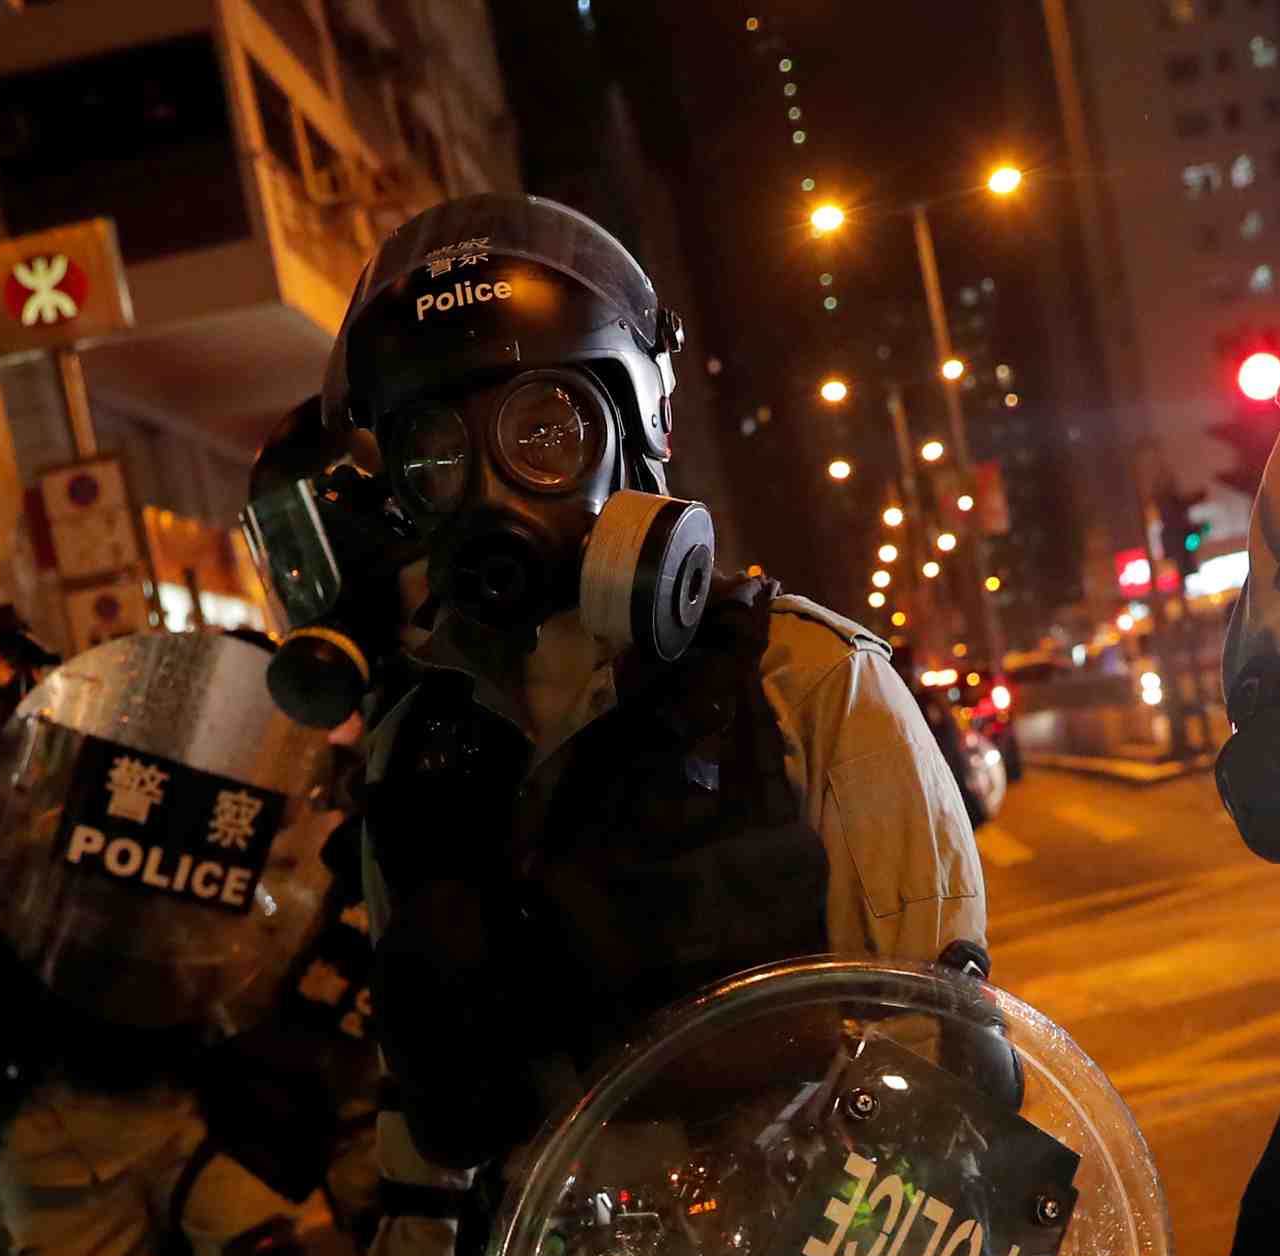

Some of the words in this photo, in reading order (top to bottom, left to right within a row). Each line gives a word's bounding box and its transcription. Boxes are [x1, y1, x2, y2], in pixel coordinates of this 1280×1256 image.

[416, 280, 513, 321] Police
[105, 755, 265, 849] 警察
[67, 824, 254, 907] POLICE
